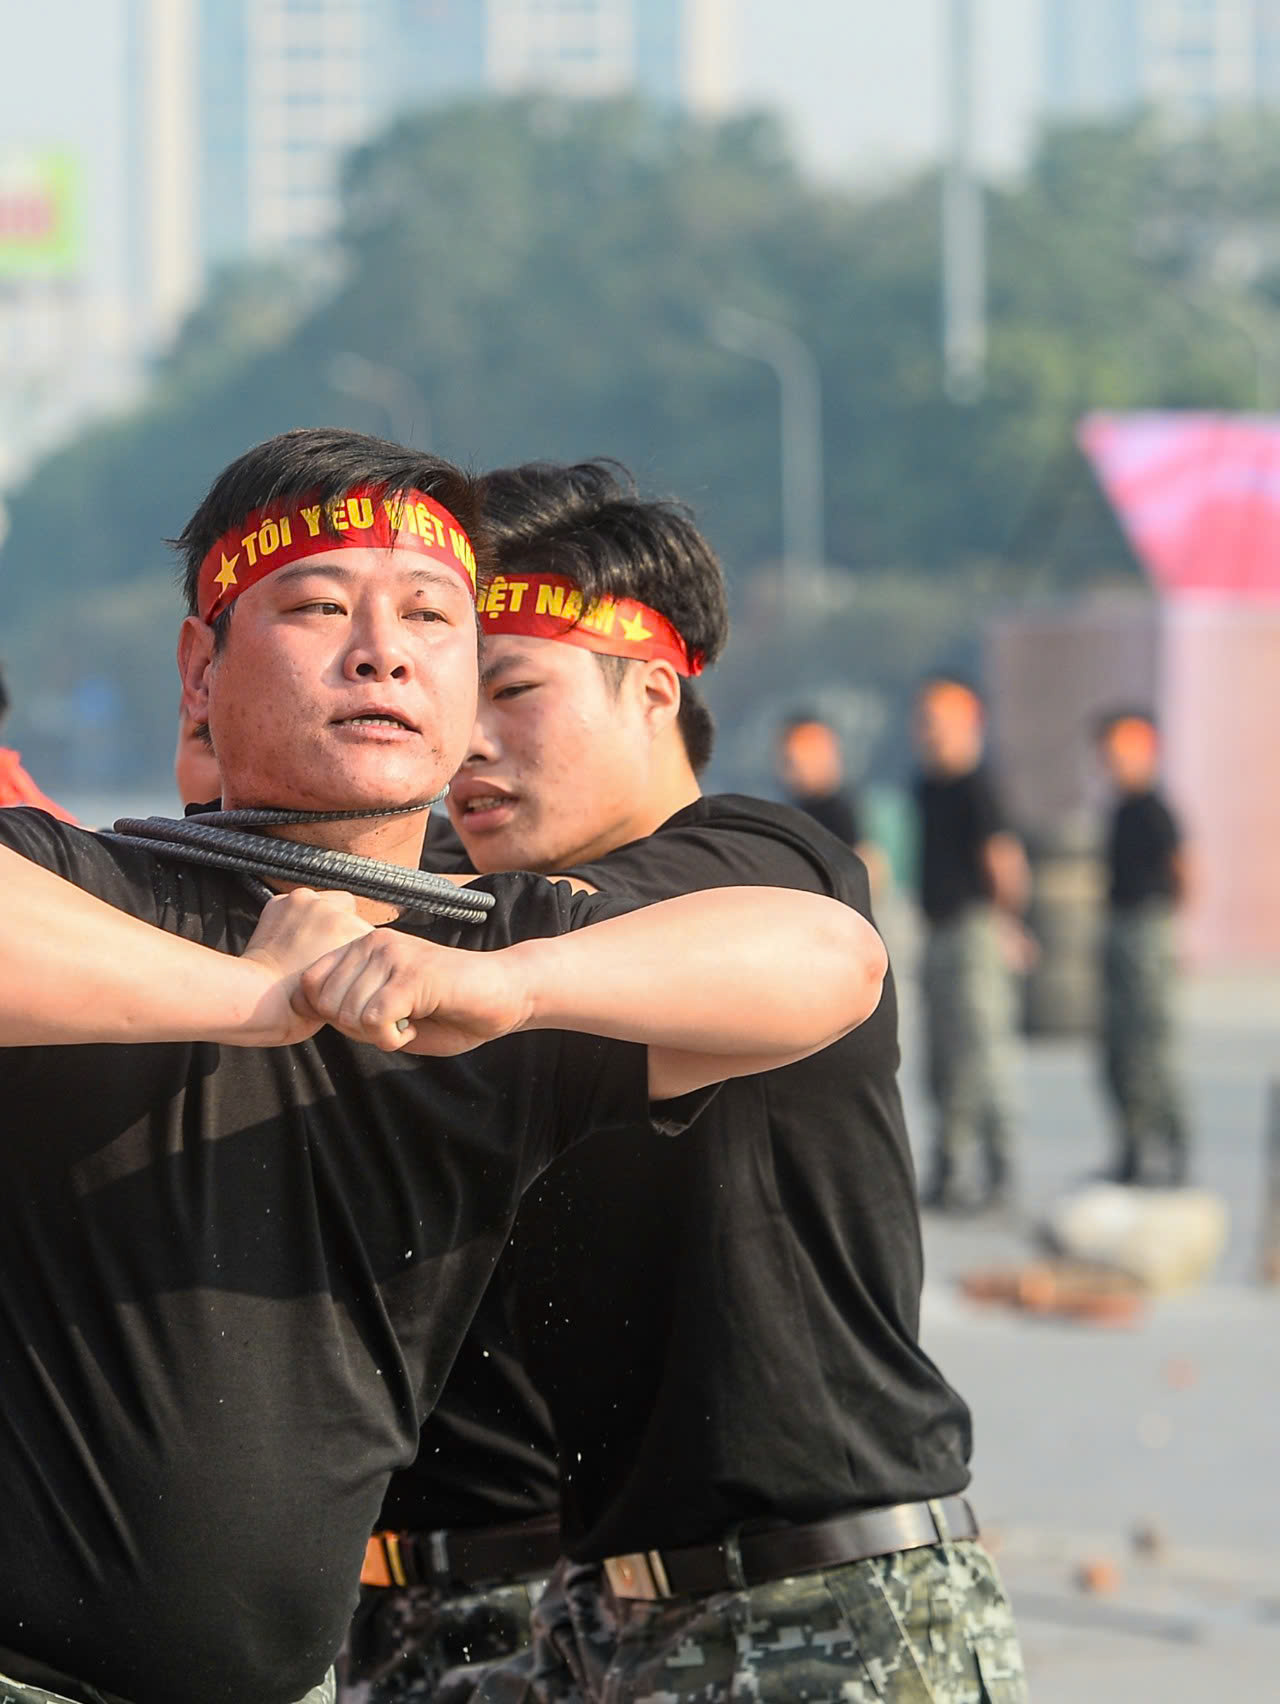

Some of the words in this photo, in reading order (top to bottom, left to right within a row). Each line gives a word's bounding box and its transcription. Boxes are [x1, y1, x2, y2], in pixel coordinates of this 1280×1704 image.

[241, 515, 293, 567] TÔI
[383, 498, 447, 548] VIỆT
[476, 575, 529, 620] IỆT
